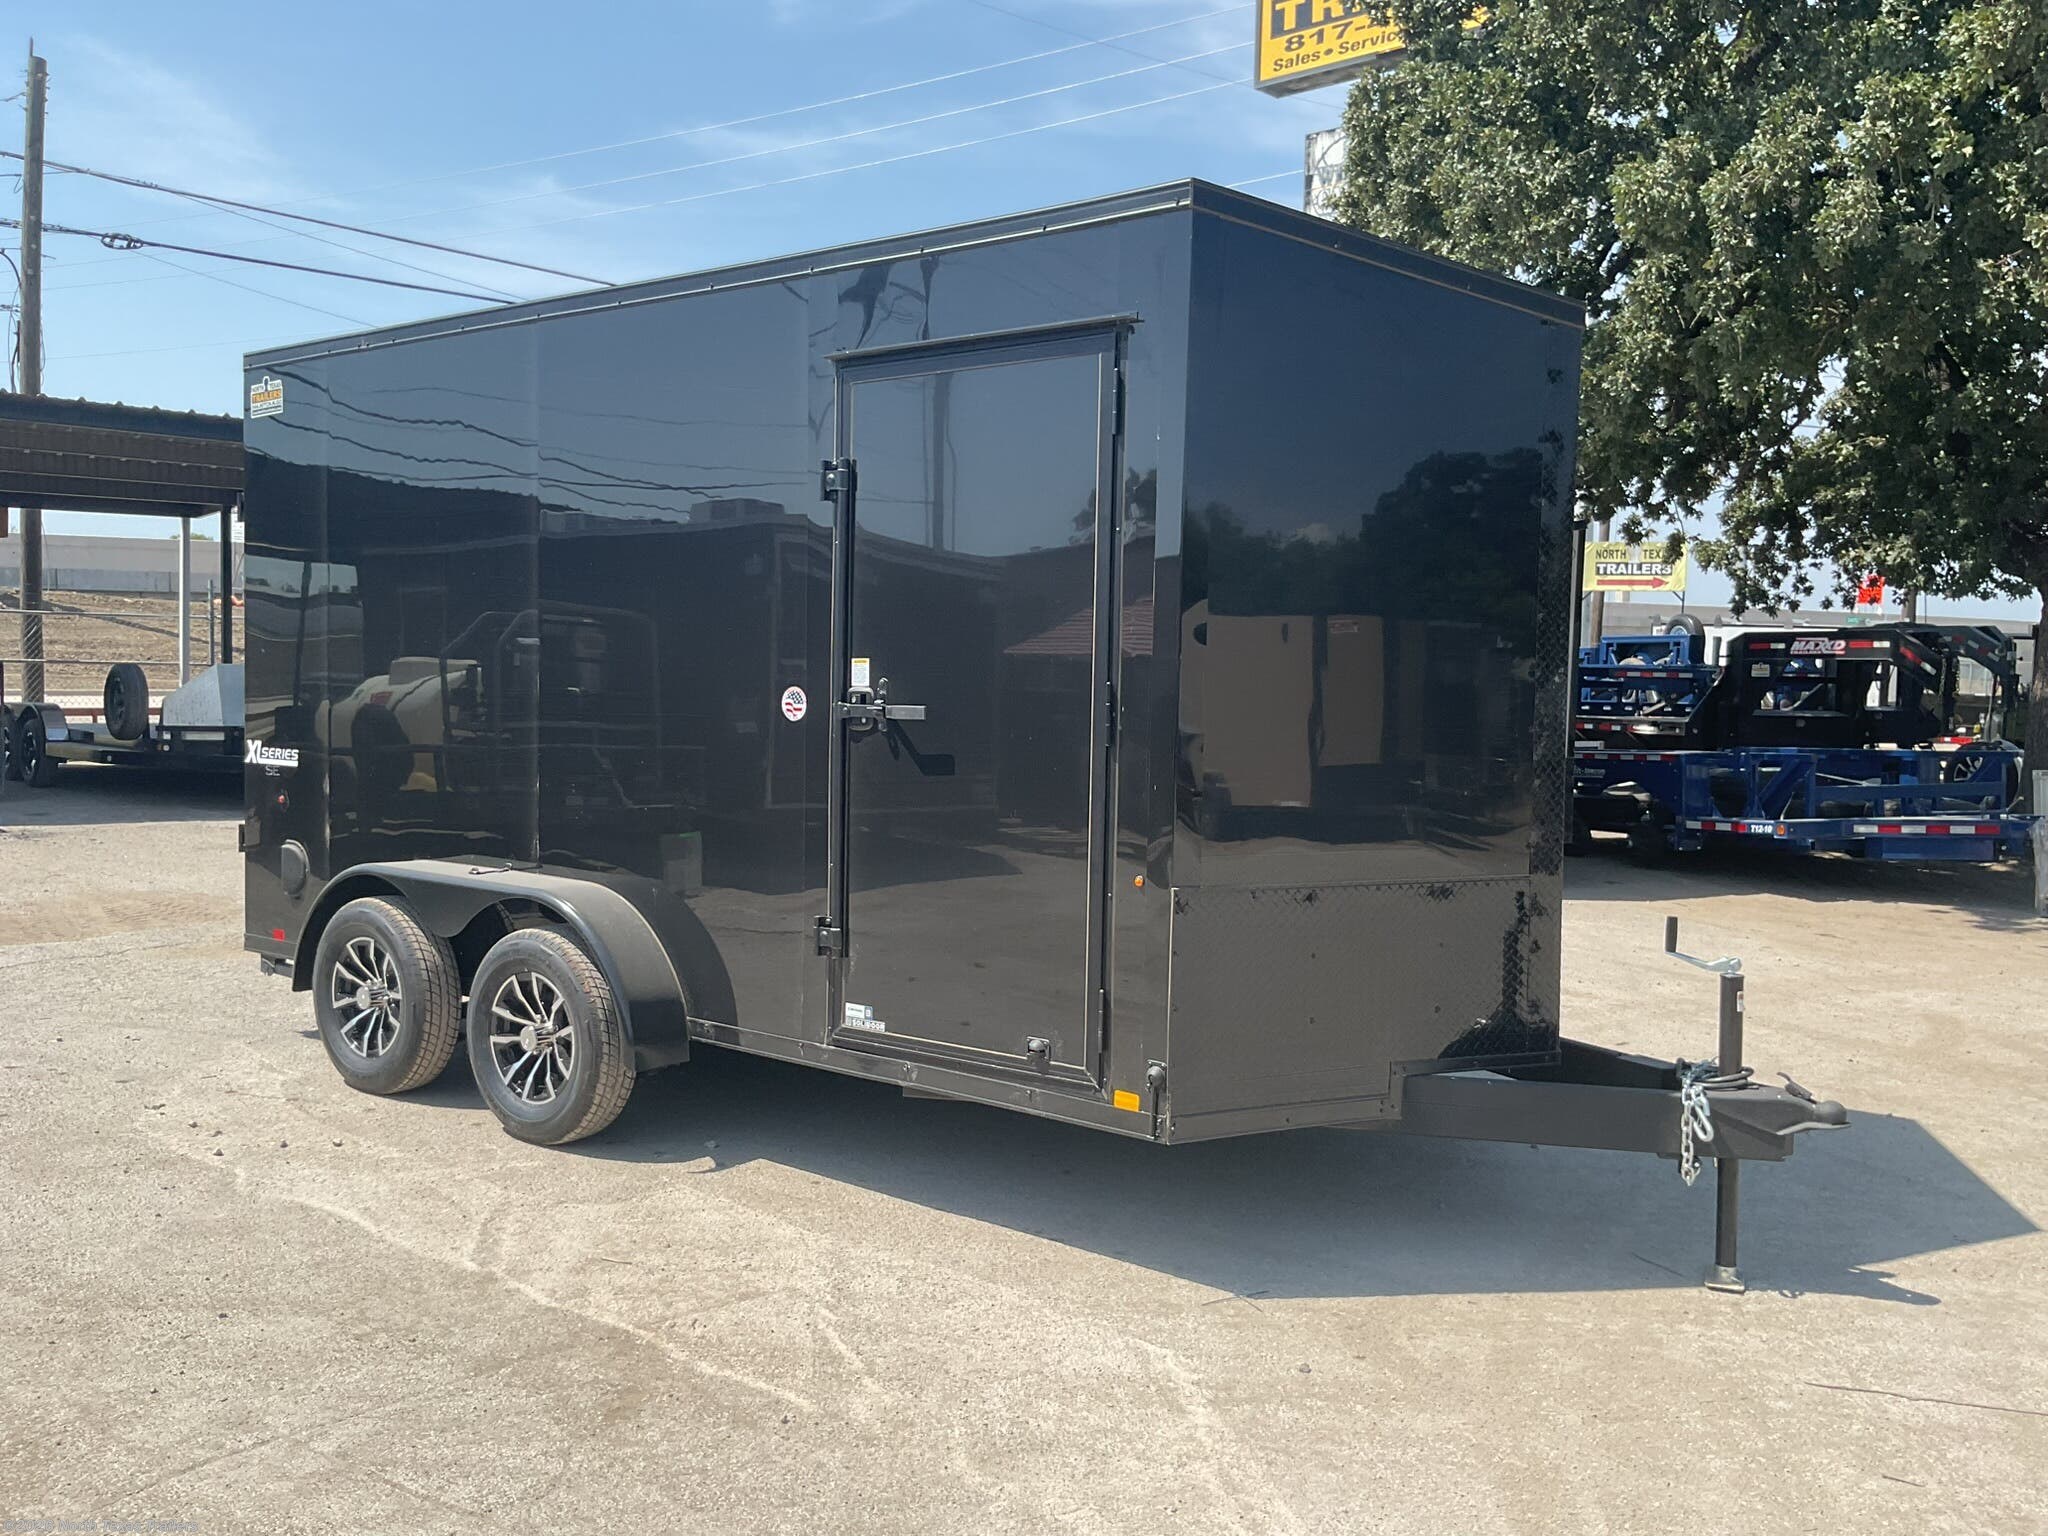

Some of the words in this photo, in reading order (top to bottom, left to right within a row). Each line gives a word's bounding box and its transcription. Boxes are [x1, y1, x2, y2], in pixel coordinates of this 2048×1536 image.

[1284, 19, 1376, 53] 817-
[1273, 50, 1321, 73] Sales
[1338, 30, 1402, 55] Servic
[252, 388, 282, 404] TRAILERS
[1595, 548, 1627, 560] NORTH
[1643, 548, 1667, 560] TEX
[1597, 563, 1672, 575] TRAILERS
[261, 747, 299, 761] SERIES
[265, 765, 281, 776] SE
